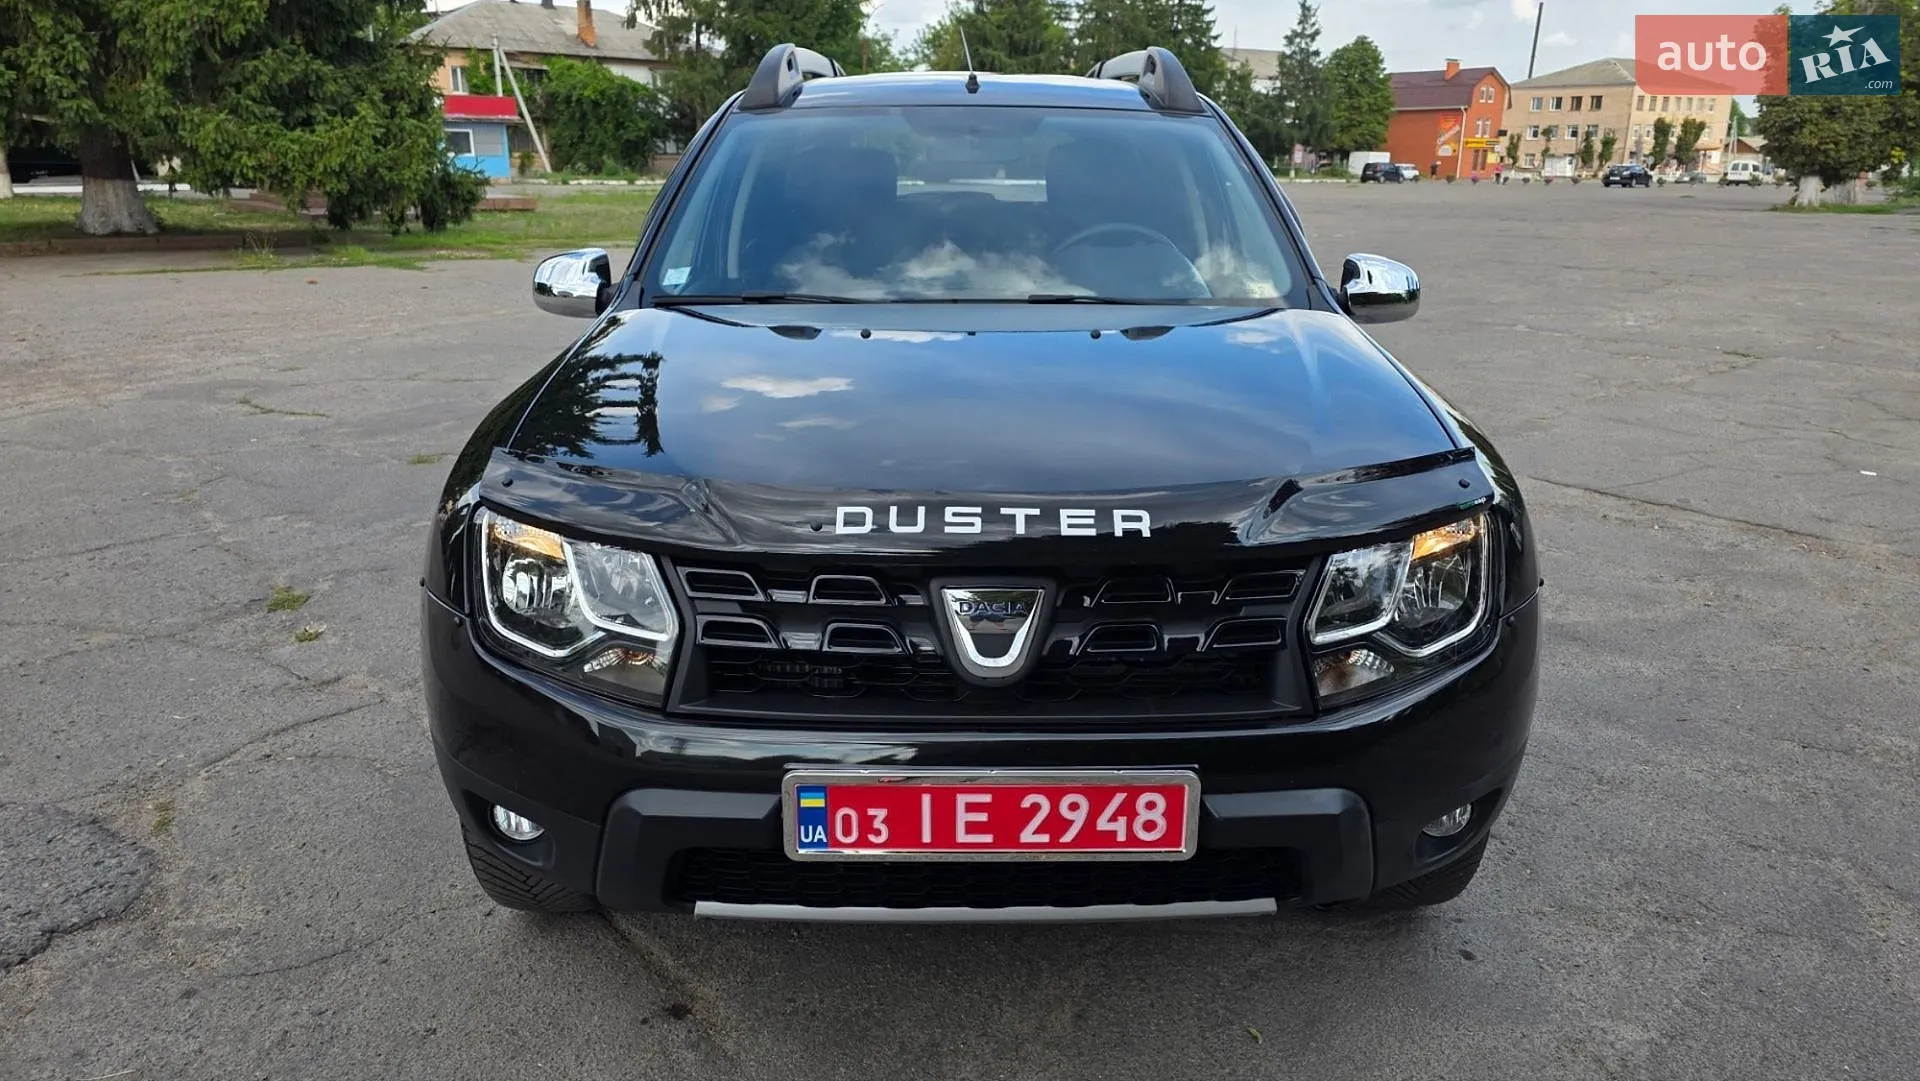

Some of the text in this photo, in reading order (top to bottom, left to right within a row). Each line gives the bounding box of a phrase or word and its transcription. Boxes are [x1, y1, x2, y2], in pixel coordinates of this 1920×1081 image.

[835, 505, 1151, 537] DUSTER
[959, 600, 1028, 616] DACIA
[834, 807, 889, 844] 03
[1019, 792, 1168, 844] 2948
[800, 826, 827, 843] UA
